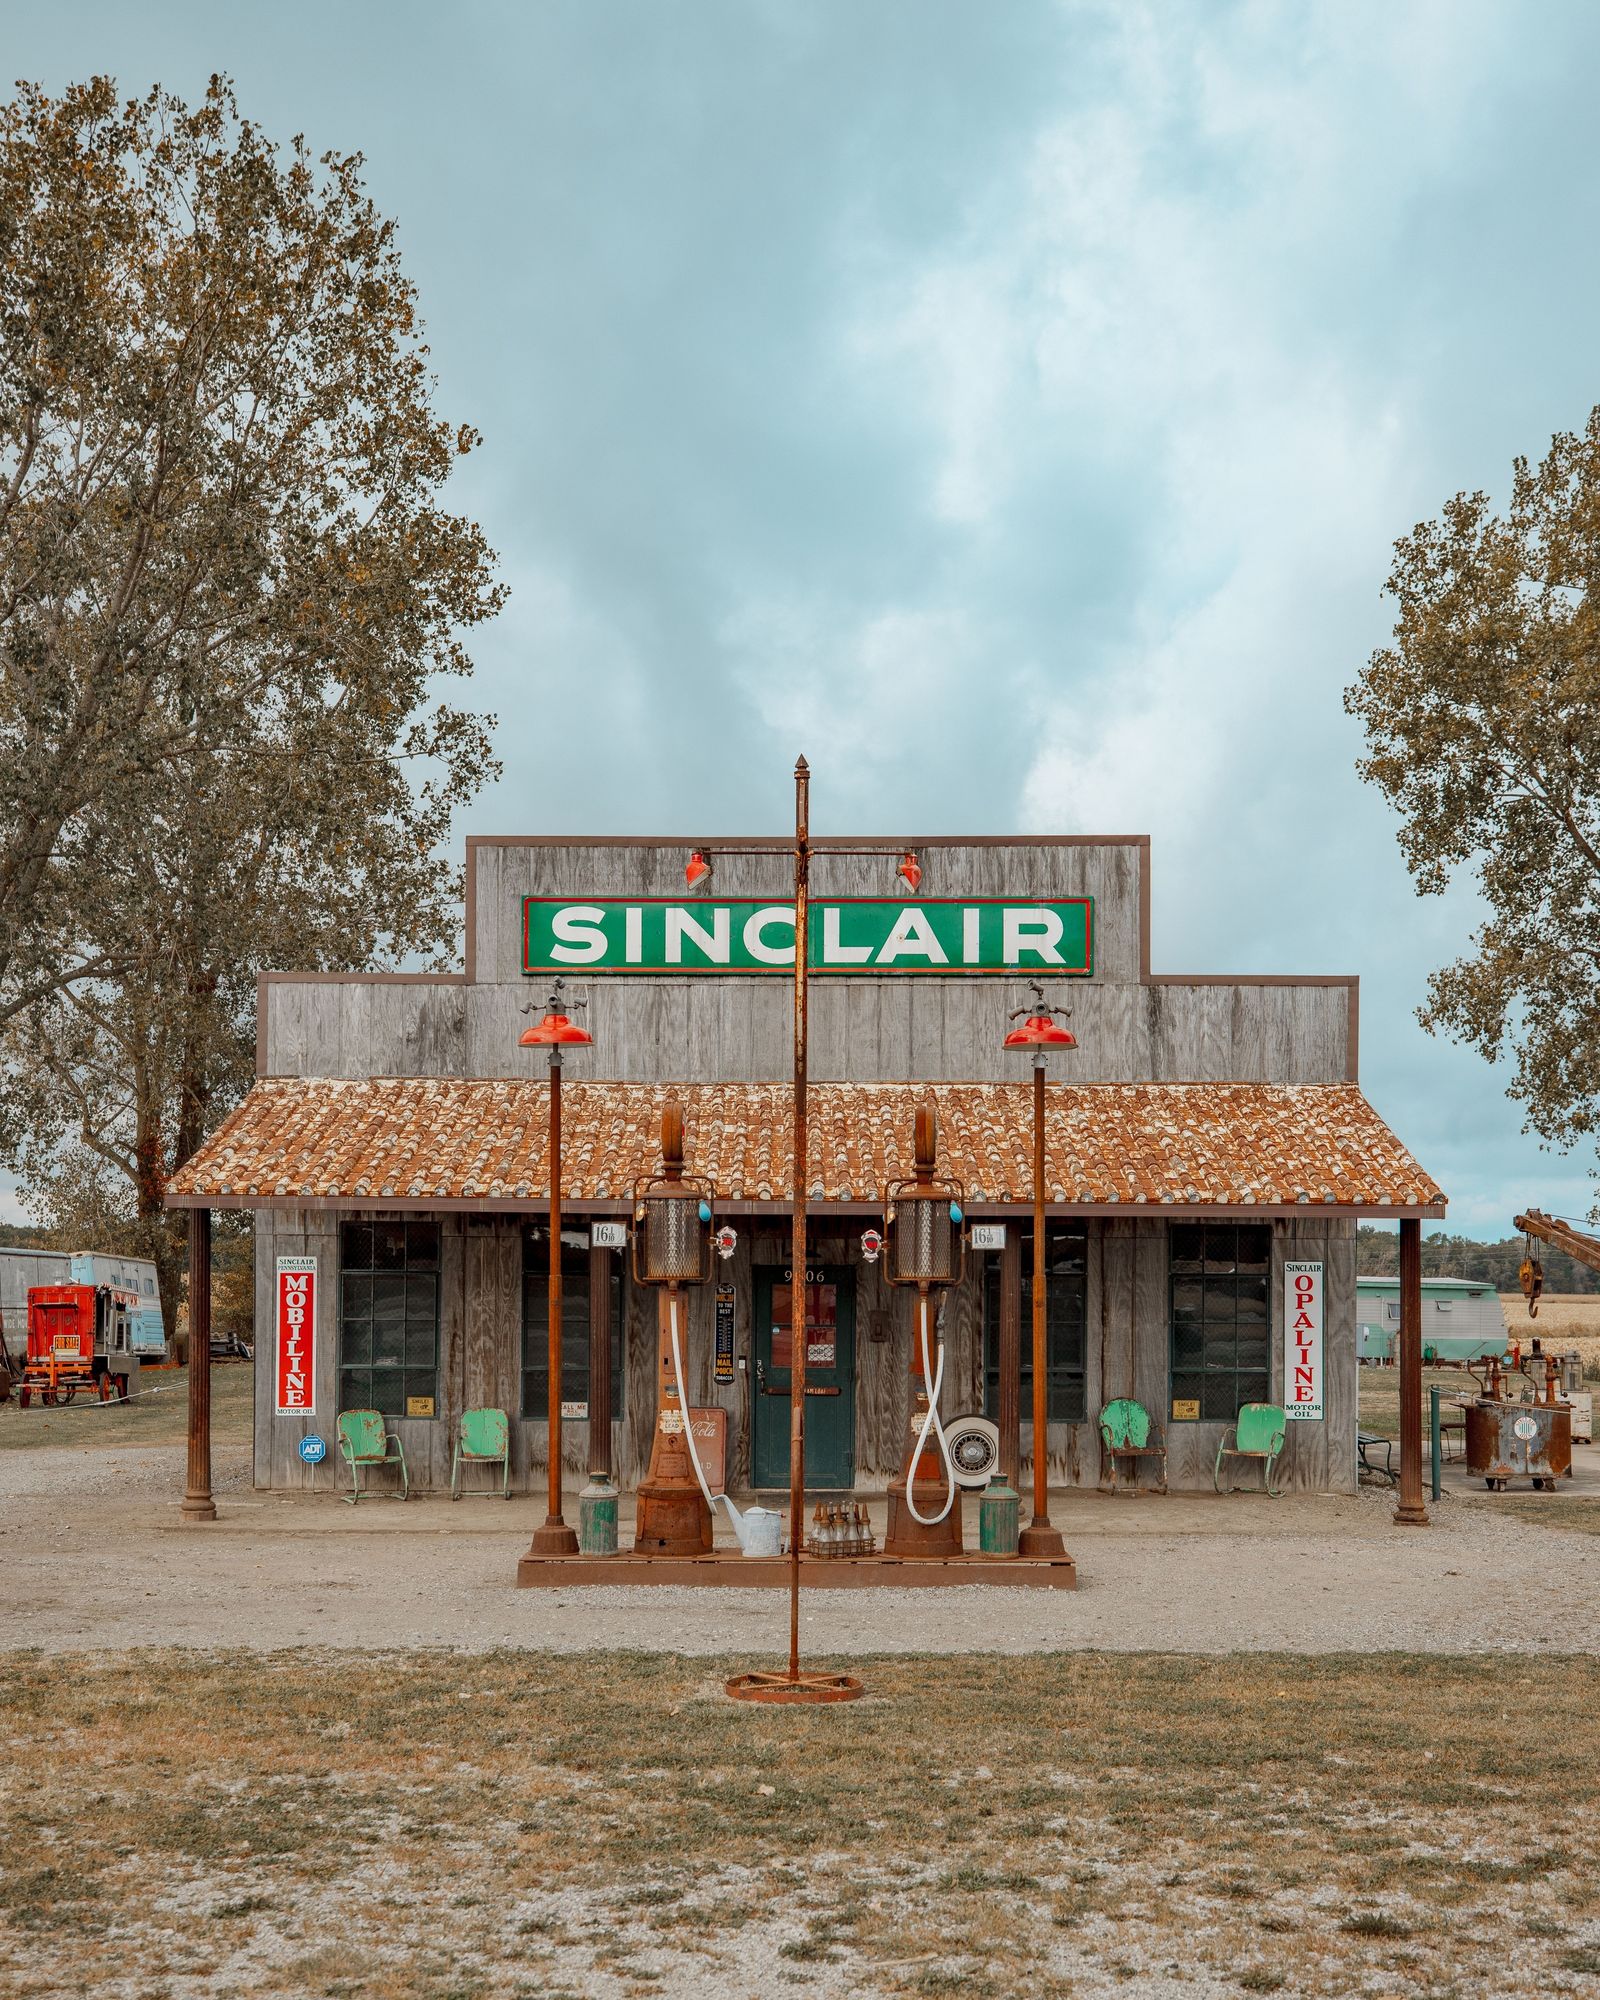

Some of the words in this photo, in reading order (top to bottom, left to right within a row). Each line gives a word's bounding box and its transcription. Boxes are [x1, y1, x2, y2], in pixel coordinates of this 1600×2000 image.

[549, 906, 1066, 964] SINCLAIR
[595, 1226, 608, 1241] 16
[974, 1228, 986, 1244] 16
[1286, 1263, 1322, 1272] SINCLAIR
[784, 1270, 825, 1282] 906
[55, 1337, 65, 1349] FOR
[66, 1337, 79, 1349] SALE
[285, 1275, 309, 1406] MOBILINE
[1293, 1275, 1315, 1402] OPALINE
[717, 1358, 732, 1366] MAIL
[716, 1367, 733, 1375] POUCH
[304, 1444, 322, 1454] ADT
